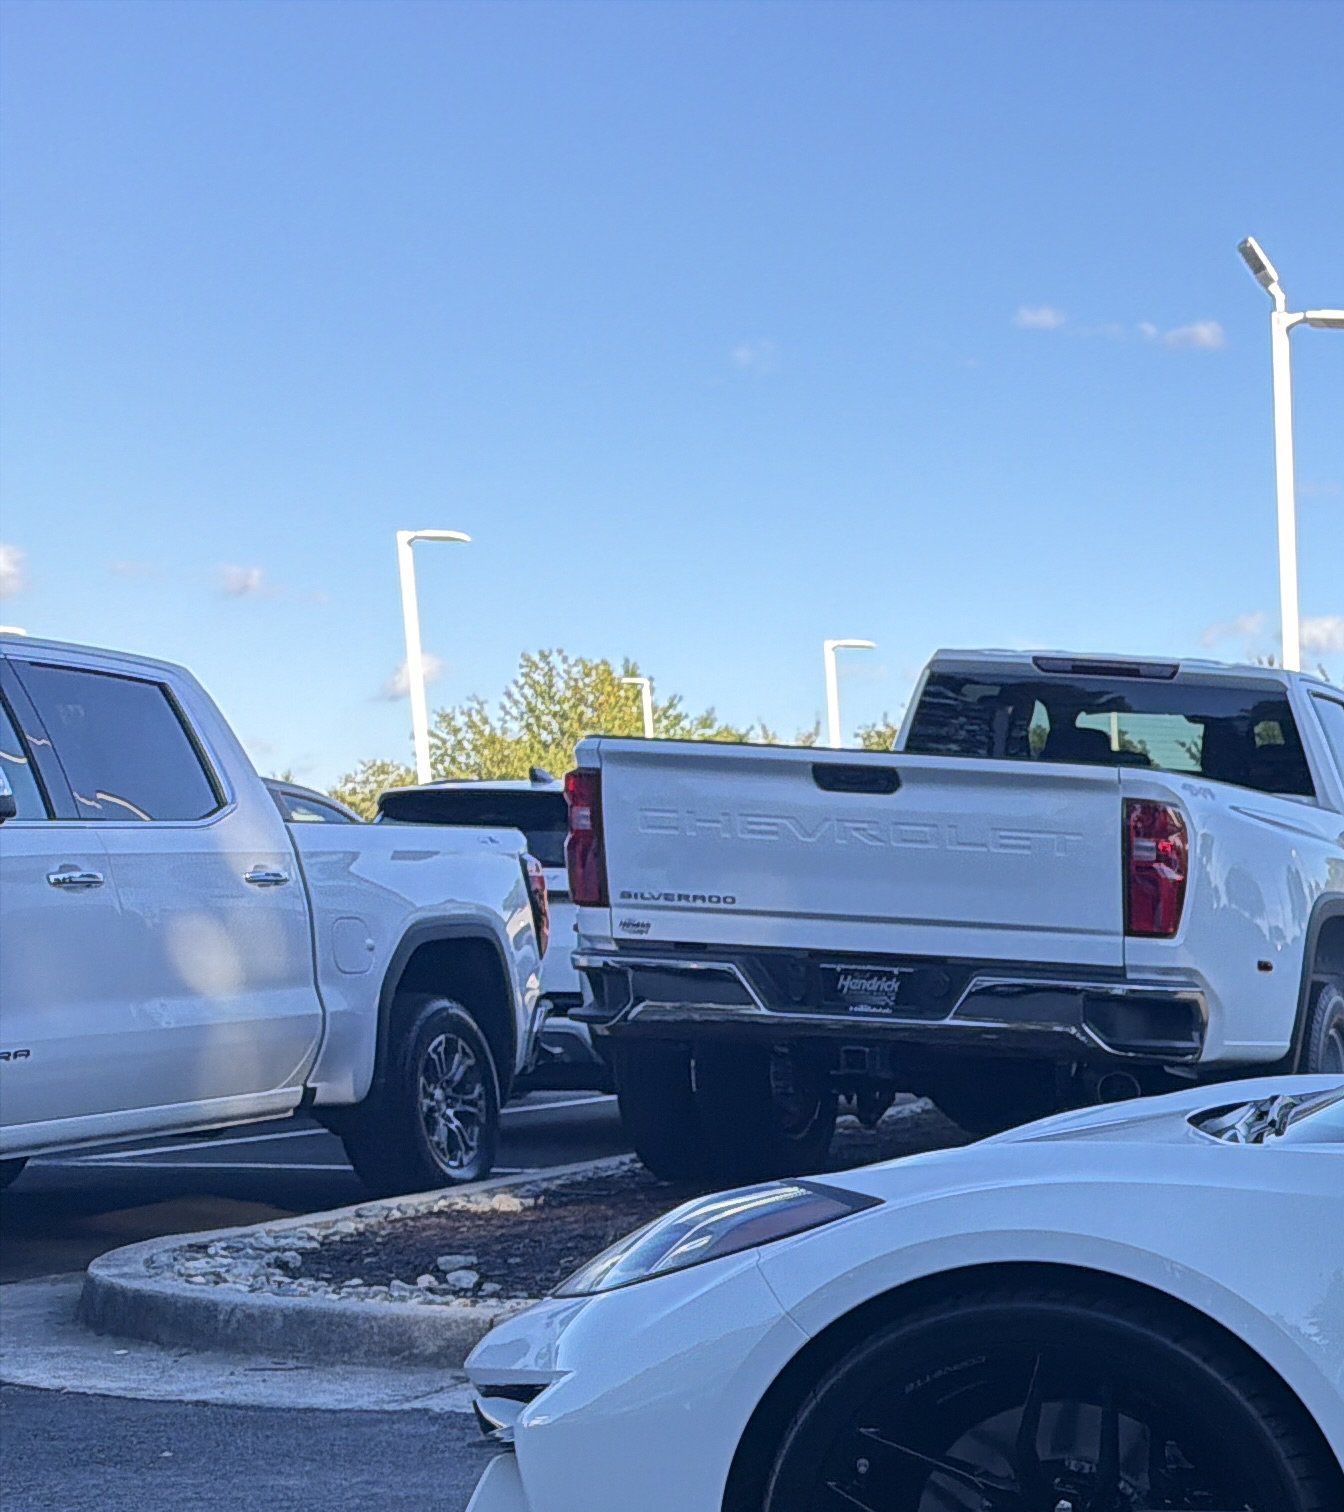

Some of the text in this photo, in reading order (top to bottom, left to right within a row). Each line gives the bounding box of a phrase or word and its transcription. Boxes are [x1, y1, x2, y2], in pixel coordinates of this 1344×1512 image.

[638, 806, 1085, 858] CHEVROLET
[619, 889, 737, 906] SILVERADO
[837, 974, 900, 994] Hendrick
